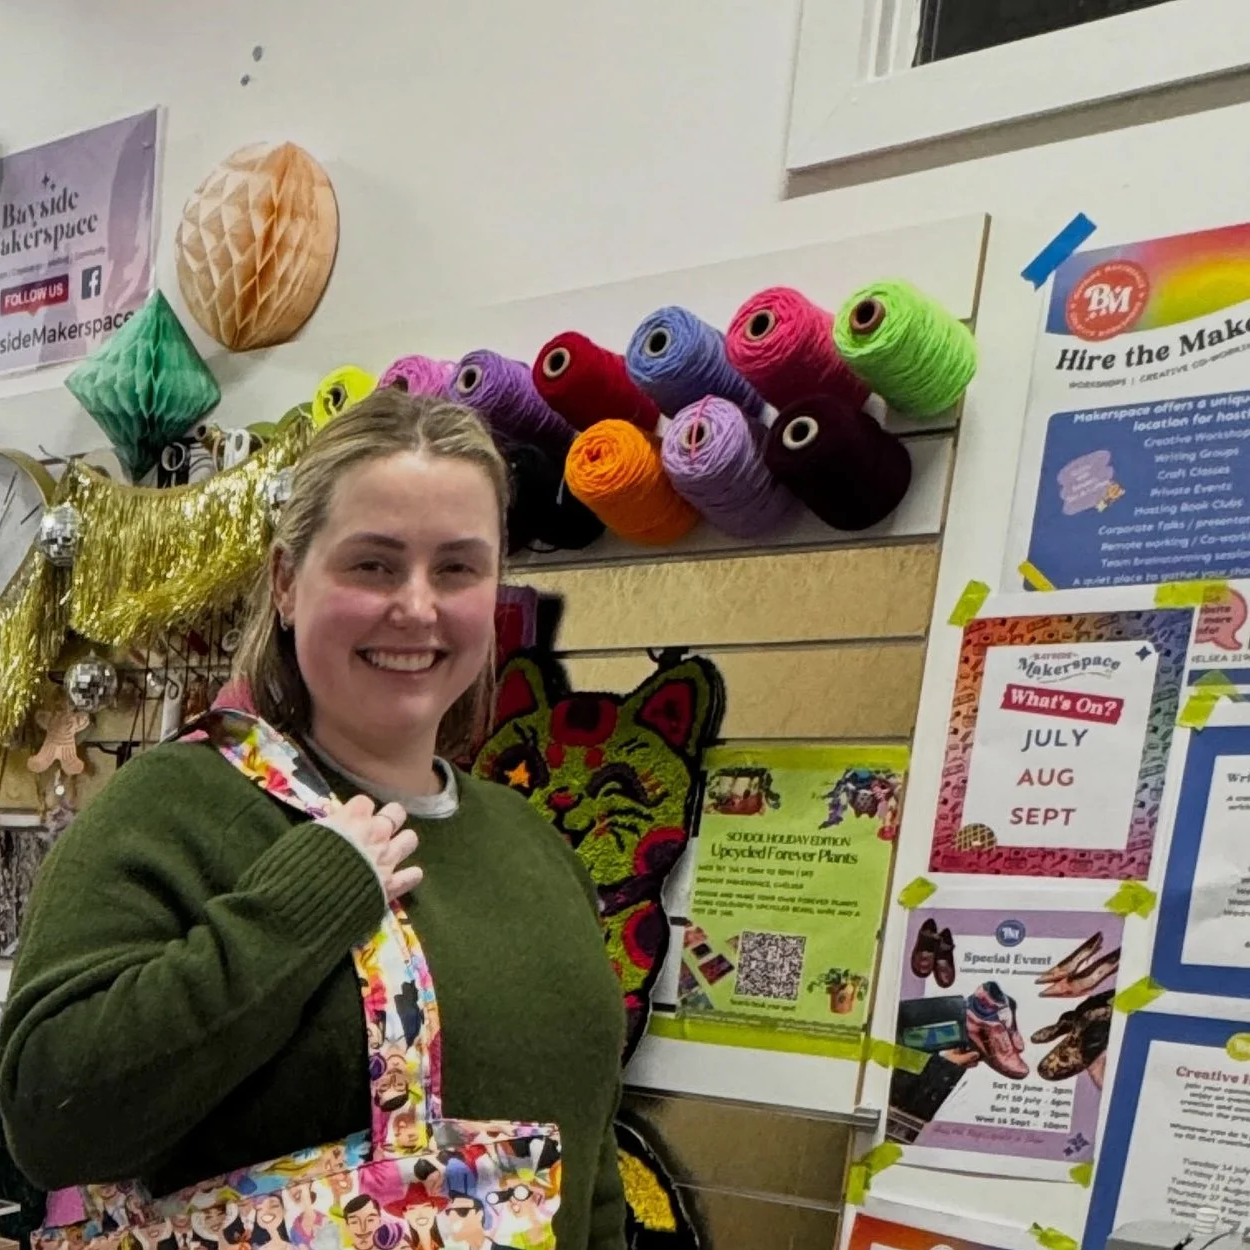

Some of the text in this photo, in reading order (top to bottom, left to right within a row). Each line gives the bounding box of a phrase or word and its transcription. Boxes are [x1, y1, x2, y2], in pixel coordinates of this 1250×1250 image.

[2, 187, 80, 229] Bayside
[5, 283, 64, 308] FOLLOW US
[1084, 283, 1133, 314] BM
[1056, 348, 1115, 371] Hire
[1125, 345, 1170, 366] the
[1139, 364, 1188, 384] CREATIVE
[1073, 407, 1150, 424] Makerspace
[1153, 401, 1193, 414] offers
[1133, 417, 1189, 432] location
[1193, 413, 1213, 426] for
[1143, 434, 1193, 448] Creative
[1154, 448, 1239, 464] Writing Groups
[1156, 465, 1230, 480] Craft Classes
[1149, 482, 1233, 497] Private Events
[1133, 504, 1178, 516] Hosting
[1212, 498, 1244, 509] Clubs
[1098, 524, 1154, 536] Corporate
[1101, 558, 1131, 568] Team
[1017, 655, 1121, 679] Makerspace
[1010, 687, 1118, 716] What's On?
[1021, 728, 1088, 752] JULY
[1016, 768, 1074, 787] AUG
[1009, 807, 1076, 826] SEPT
[726, 832, 851, 847] SCHOOL HOLIDAY EDITION
[711, 843, 858, 864] Upcycled Forever Plants
[964, 952, 1052, 965] Special Event
[1176, 1066, 1239, 1083] Creative
[993, 1081, 1007, 1089] Sat
[1023, 1109, 1040, 1117] Aug
[1183, 1158, 1218, 1169] Tuesday
[1171, 1177, 1207, 1189] Tuesday
[1168, 1187, 1206, 1200] Thursday
